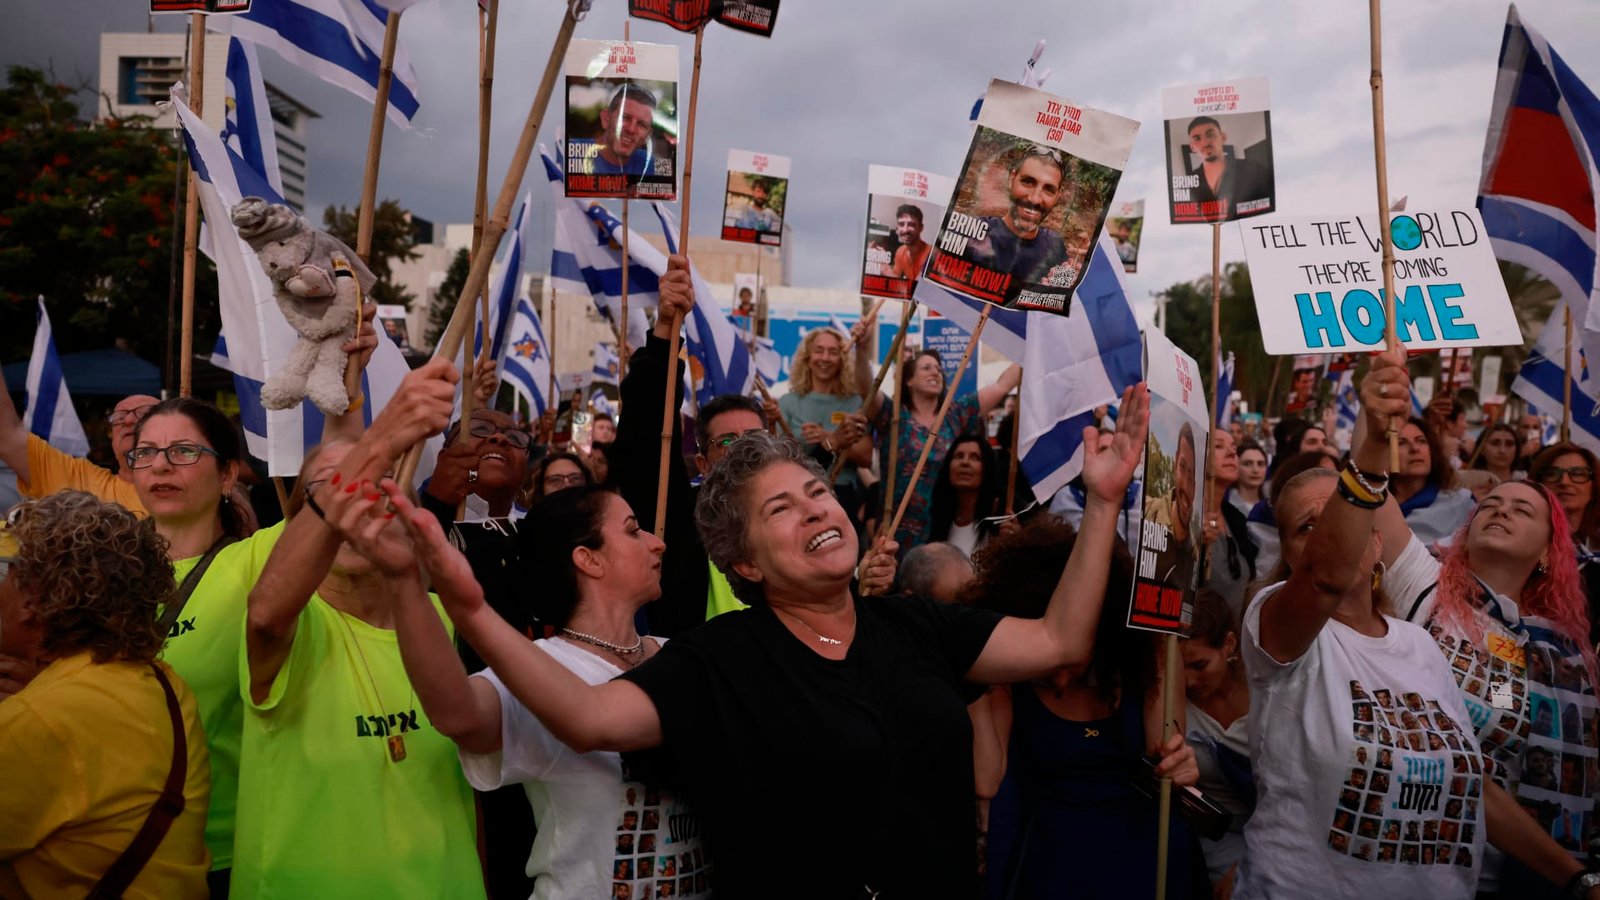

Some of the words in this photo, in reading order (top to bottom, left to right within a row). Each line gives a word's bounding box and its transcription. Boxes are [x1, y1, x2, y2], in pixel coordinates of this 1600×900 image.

[1036, 112, 1060, 129] TAMIR
[1060, 119, 1082, 136] ADAR
[1046, 129, 1063, 143] (38)
[568, 142, 598, 158] BRING
[568, 175, 597, 191] HOME
[1172, 174, 1199, 189] BRING
[1173, 188, 1191, 202] HIM
[1174, 202, 1199, 216] HOME
[947, 211, 989, 241] BRING
[1252, 225, 1307, 249] TELL
[1311, 221, 1357, 246] THE
[867, 247, 892, 264] BRING
[940, 231, 969, 257] HIM
[932, 252, 971, 283] HOME
[971, 264, 1013, 296] NOW!
[1299, 259, 1376, 285] THEY'RE
[1391, 257, 1448, 280] OMING
[1294, 283, 1480, 348] HOME
[1142, 520, 1168, 552] BRING
[1139, 549, 1158, 580] HIM
[1135, 582, 1161, 613] HOME
